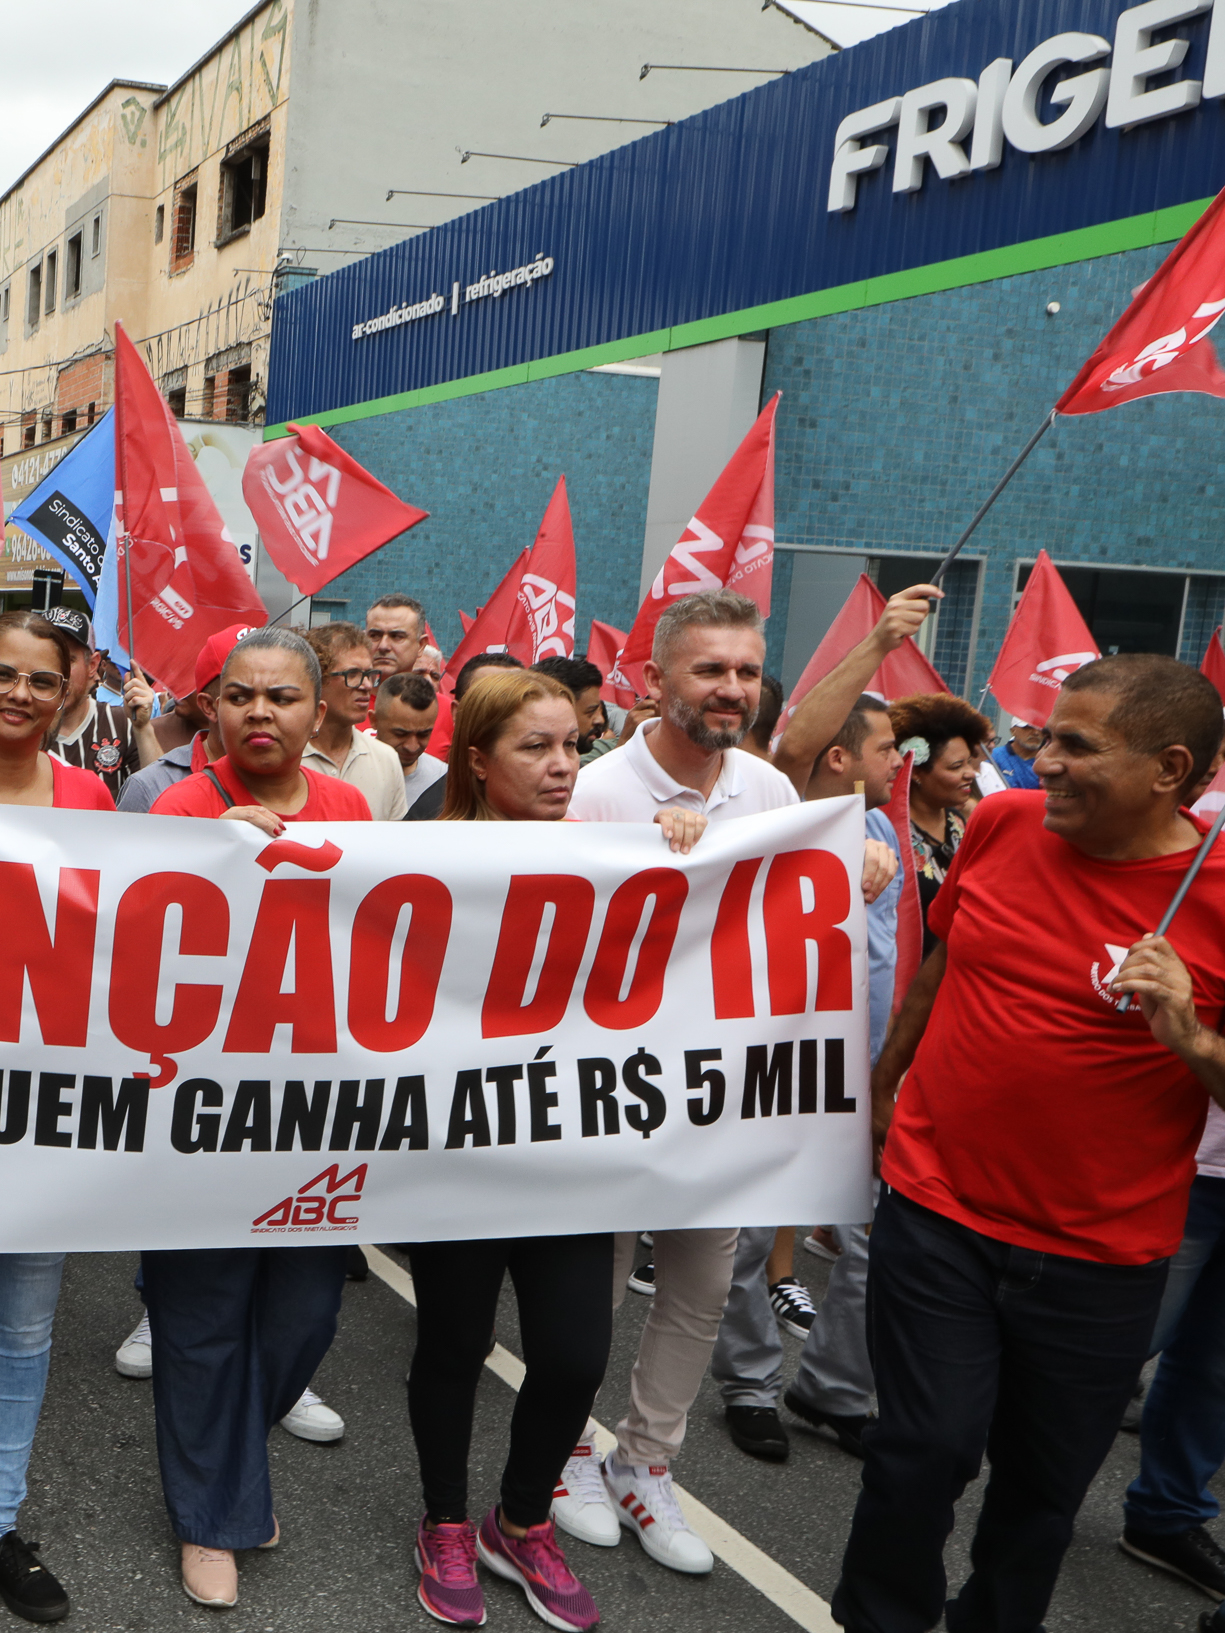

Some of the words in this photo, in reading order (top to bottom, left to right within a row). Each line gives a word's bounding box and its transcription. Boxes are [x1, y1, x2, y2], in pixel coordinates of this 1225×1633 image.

[352, 292, 445, 340] ar-condicionado
[465, 252, 555, 302] refrigeração
[48, 499, 100, 555] Sindicato
[62, 533, 96, 575] Santo
[482, 867, 689, 1039] DO
[711, 848, 853, 1020] IR
[171, 1074, 429, 1154] GANHA
[444, 1045, 562, 1150] ATÉ
[577, 1046, 666, 1140] R$
[684, 1047, 726, 1126] 5
[741, 1038, 857, 1119] MIL
[297, 1163, 369, 1195] M
[252, 1194, 362, 1227] ABC
